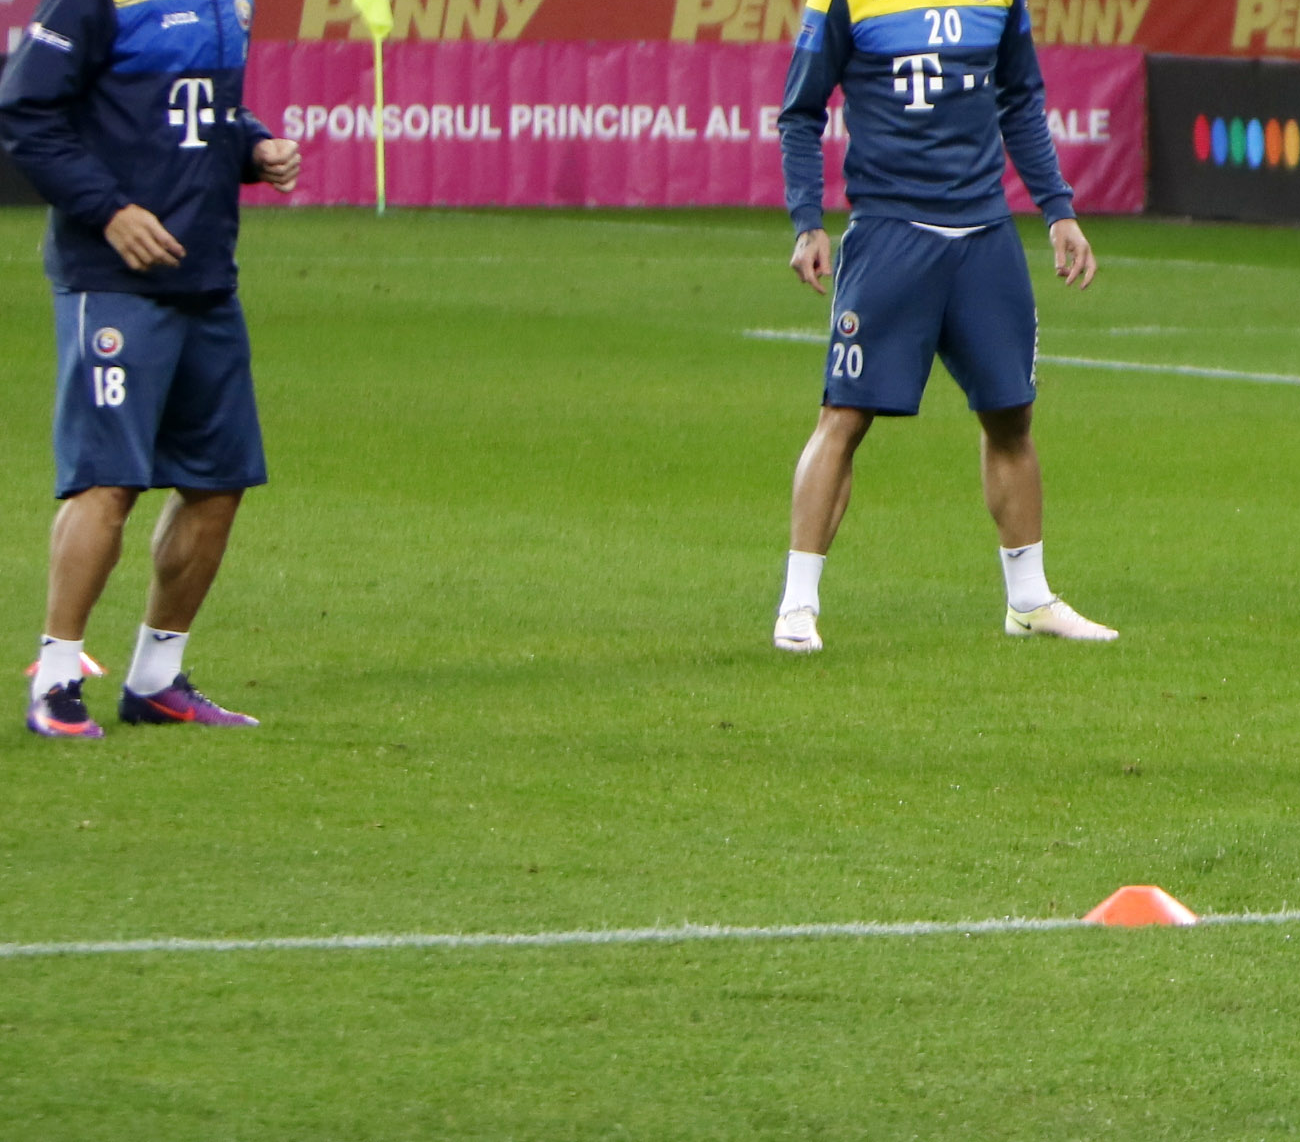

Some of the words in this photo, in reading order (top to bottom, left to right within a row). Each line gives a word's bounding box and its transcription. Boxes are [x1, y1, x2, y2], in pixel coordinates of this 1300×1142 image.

[924, 8, 962, 45] 20
[283, 104, 501, 141] SPONSORUL
[510, 104, 697, 141] PRINCIPAL
[704, 105, 750, 141] AL
[831, 342, 864, 379] 20
[93, 365, 126, 408] 18
